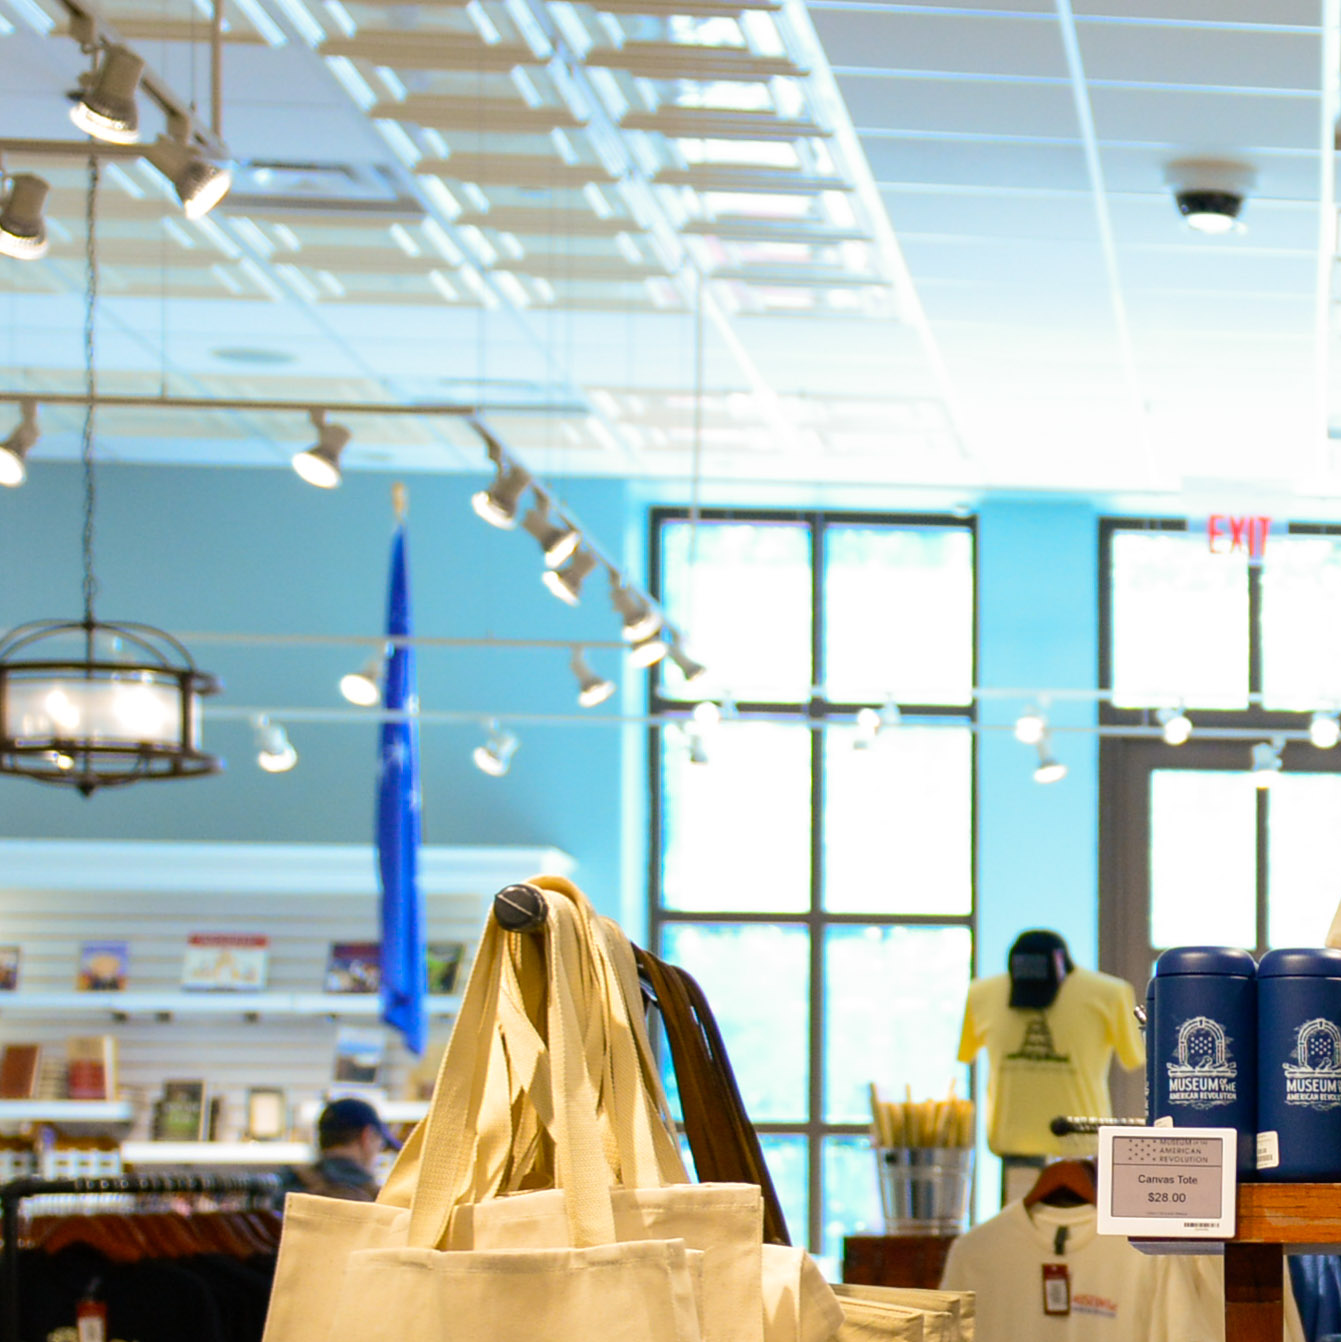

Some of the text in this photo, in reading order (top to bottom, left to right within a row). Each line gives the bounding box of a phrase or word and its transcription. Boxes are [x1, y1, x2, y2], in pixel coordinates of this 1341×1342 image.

[1208, 514, 1271, 556] EXIT
[1169, 1077, 1218, 1092] MUSEUM
[1286, 1079, 1337, 1093] MUSEUM
[1138, 1174, 1198, 1185] Canvas Tote
[1148, 1192, 1187, 1203] $28.00
